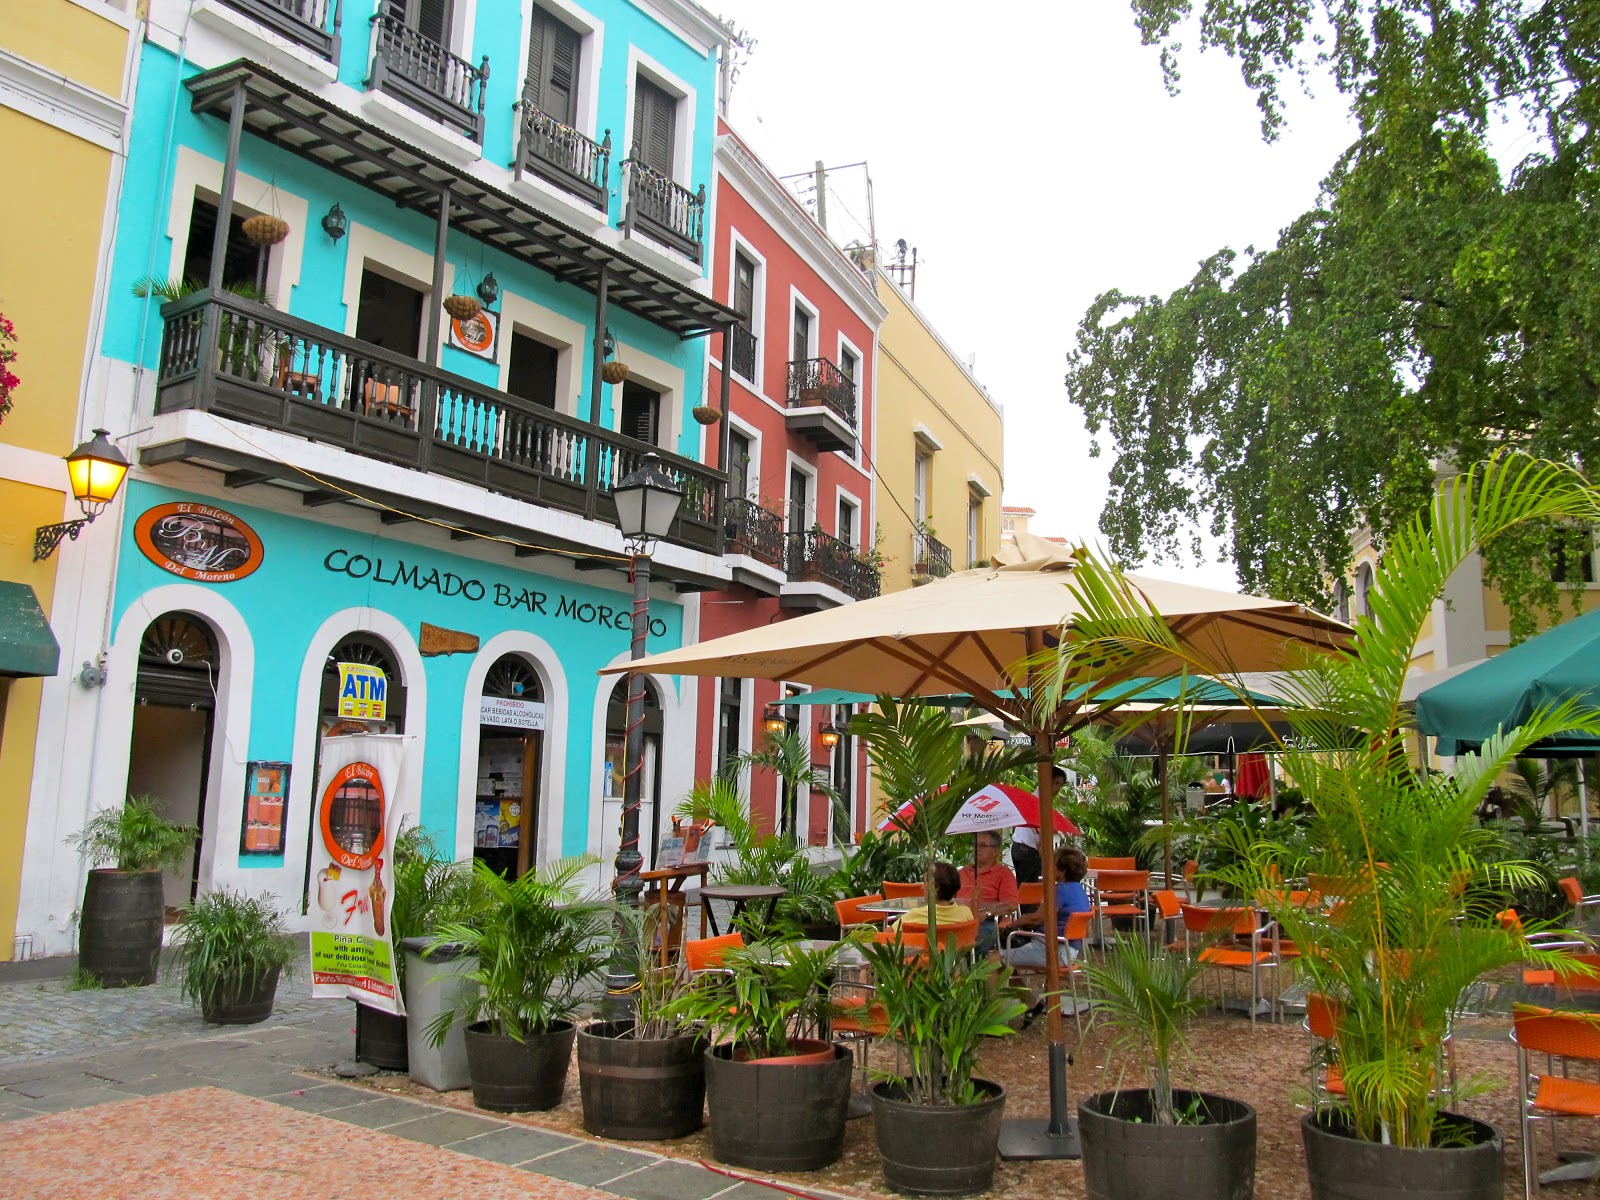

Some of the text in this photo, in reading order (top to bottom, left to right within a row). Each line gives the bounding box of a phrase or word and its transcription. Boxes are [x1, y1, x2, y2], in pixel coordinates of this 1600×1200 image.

[177, 503, 193, 512] El
[165, 561, 235, 581] Del Moreno
[323, 549, 486, 601] COLMADO
[493, 583, 548, 616] BAR
[342, 673, 385, 701] ATM
[496, 700, 525, 708] PROHIBIDO
[492, 708, 512, 716] BEBIDAS
[334, 934, 353, 944] Piña
[335, 953, 366, 962] deliciou
[315, 974, 336, 983] Puerto
